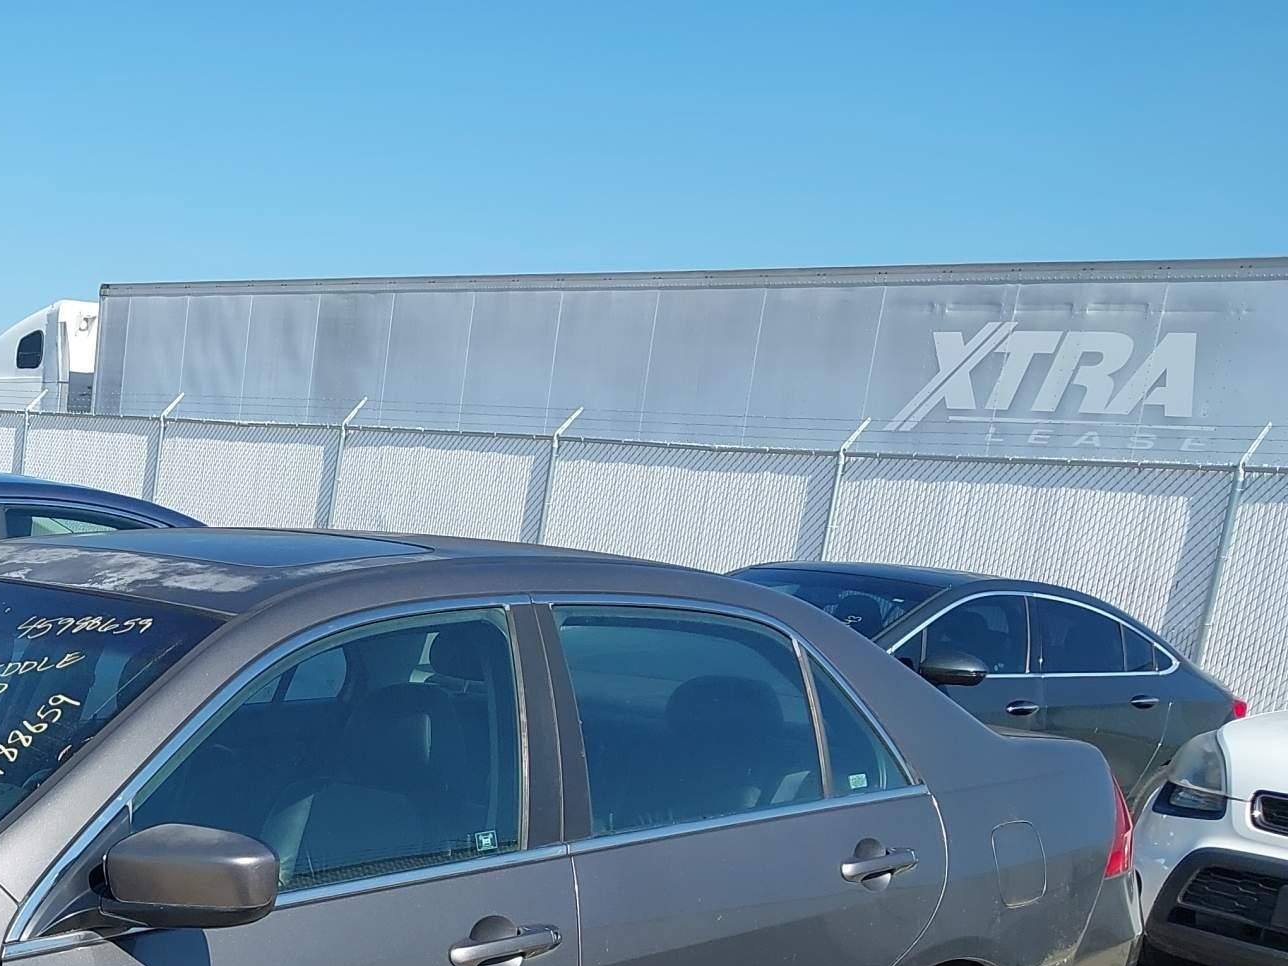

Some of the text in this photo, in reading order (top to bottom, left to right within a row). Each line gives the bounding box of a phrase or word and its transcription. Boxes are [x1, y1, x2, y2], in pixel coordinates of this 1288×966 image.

[884, 321, 1198, 432] XTRA
[984, 426, 1208, 452] LEASE
[16, 616, 153, 640] 45988659
